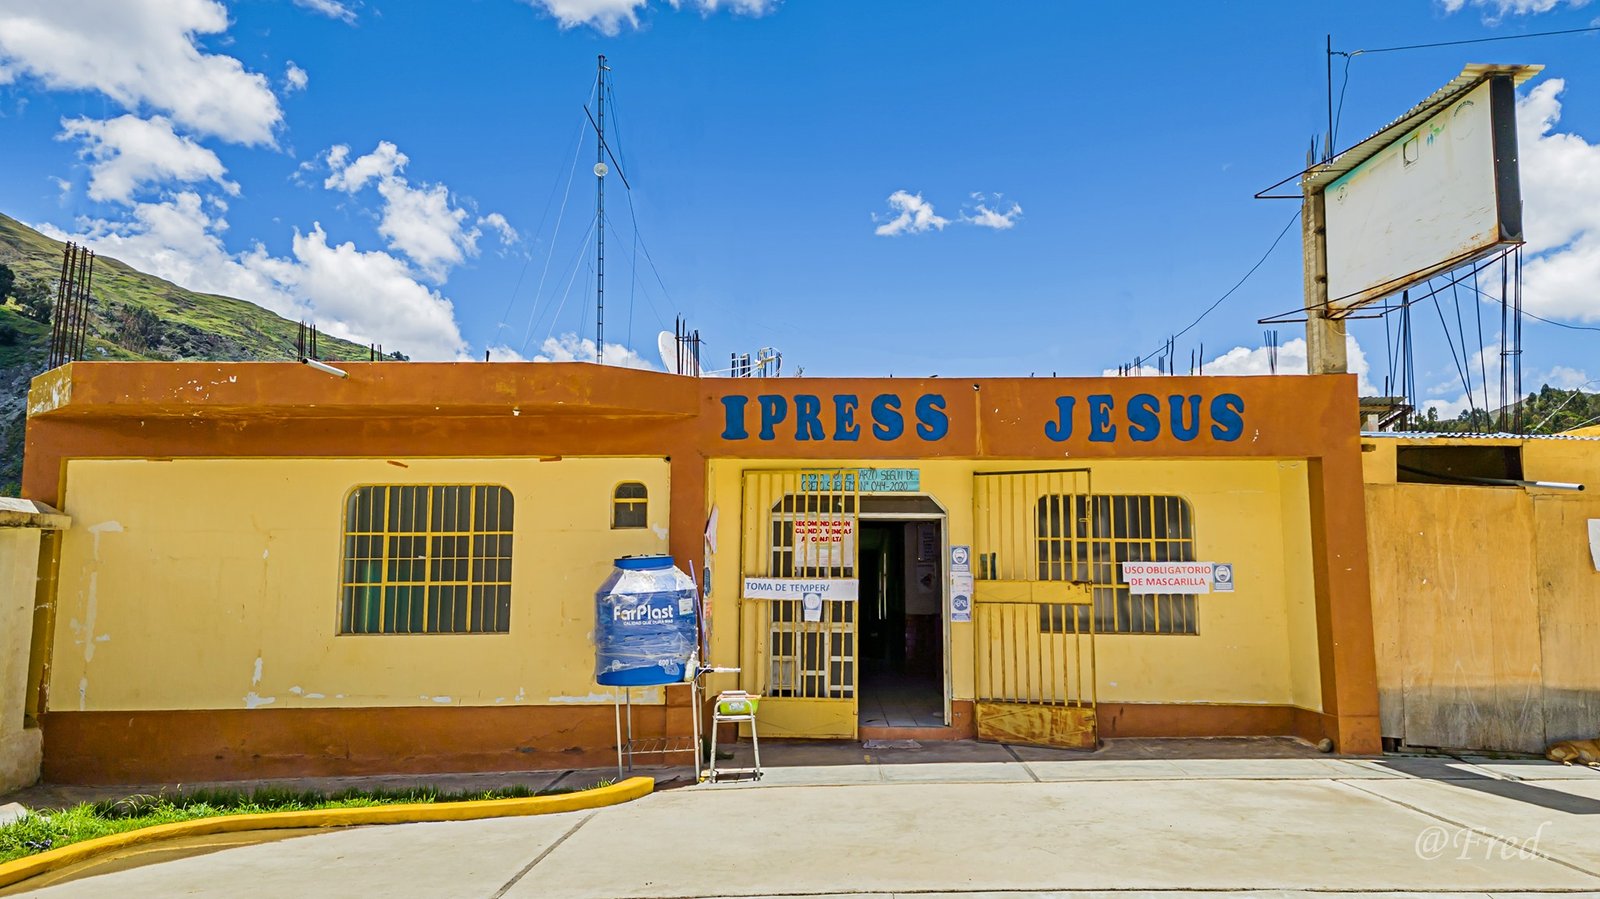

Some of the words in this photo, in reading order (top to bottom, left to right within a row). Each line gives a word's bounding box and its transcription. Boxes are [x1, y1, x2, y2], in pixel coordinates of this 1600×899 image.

[720, 393, 949, 441] IPRESS
[1044, 393, 1245, 442] JESUS
[871, 480, 909, 492] 044-2020
[1124, 566, 1144, 574] USO
[1146, 566, 1212, 575] OBLIGATORIO
[745, 582, 773, 591] TOMA
[775, 583, 787, 591] DE
[1131, 578, 1143, 586] DE
[1146, 578, 1206, 586] MASCARILLA
[613, 605, 674, 621] FarPlast
